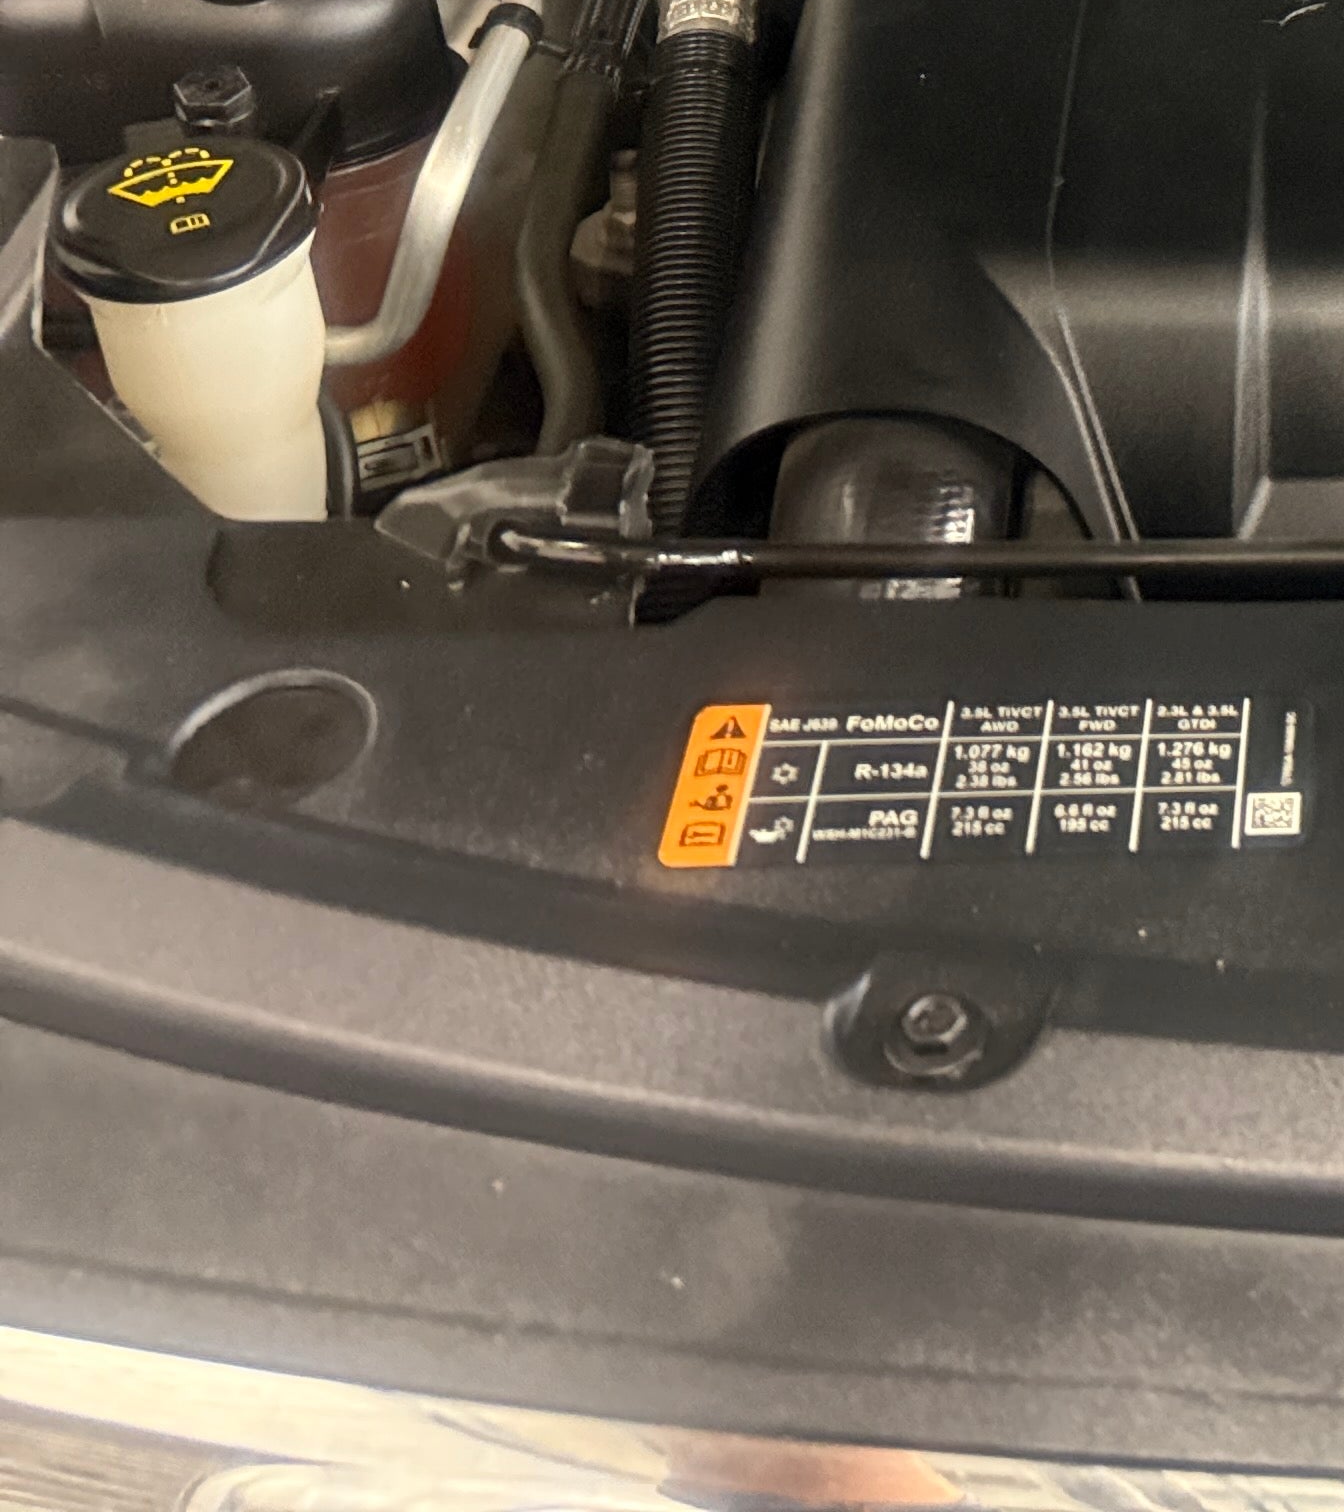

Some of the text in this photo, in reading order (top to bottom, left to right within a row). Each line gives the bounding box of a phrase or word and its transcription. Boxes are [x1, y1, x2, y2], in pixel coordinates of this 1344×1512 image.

[769, 717, 800, 733] SAE
[845, 714, 940, 732] FoMoCo
[980, 720, 1020, 733] AWD
[1078, 719, 1117, 732] FWD
[954, 744, 1031, 763] 1.077 kg
[1057, 742, 1132, 761] 1.162 kg
[1157, 741, 1233, 760] 1.276 kg
[854, 762, 929, 780] R-134a
[868, 809, 919, 827] PAG
